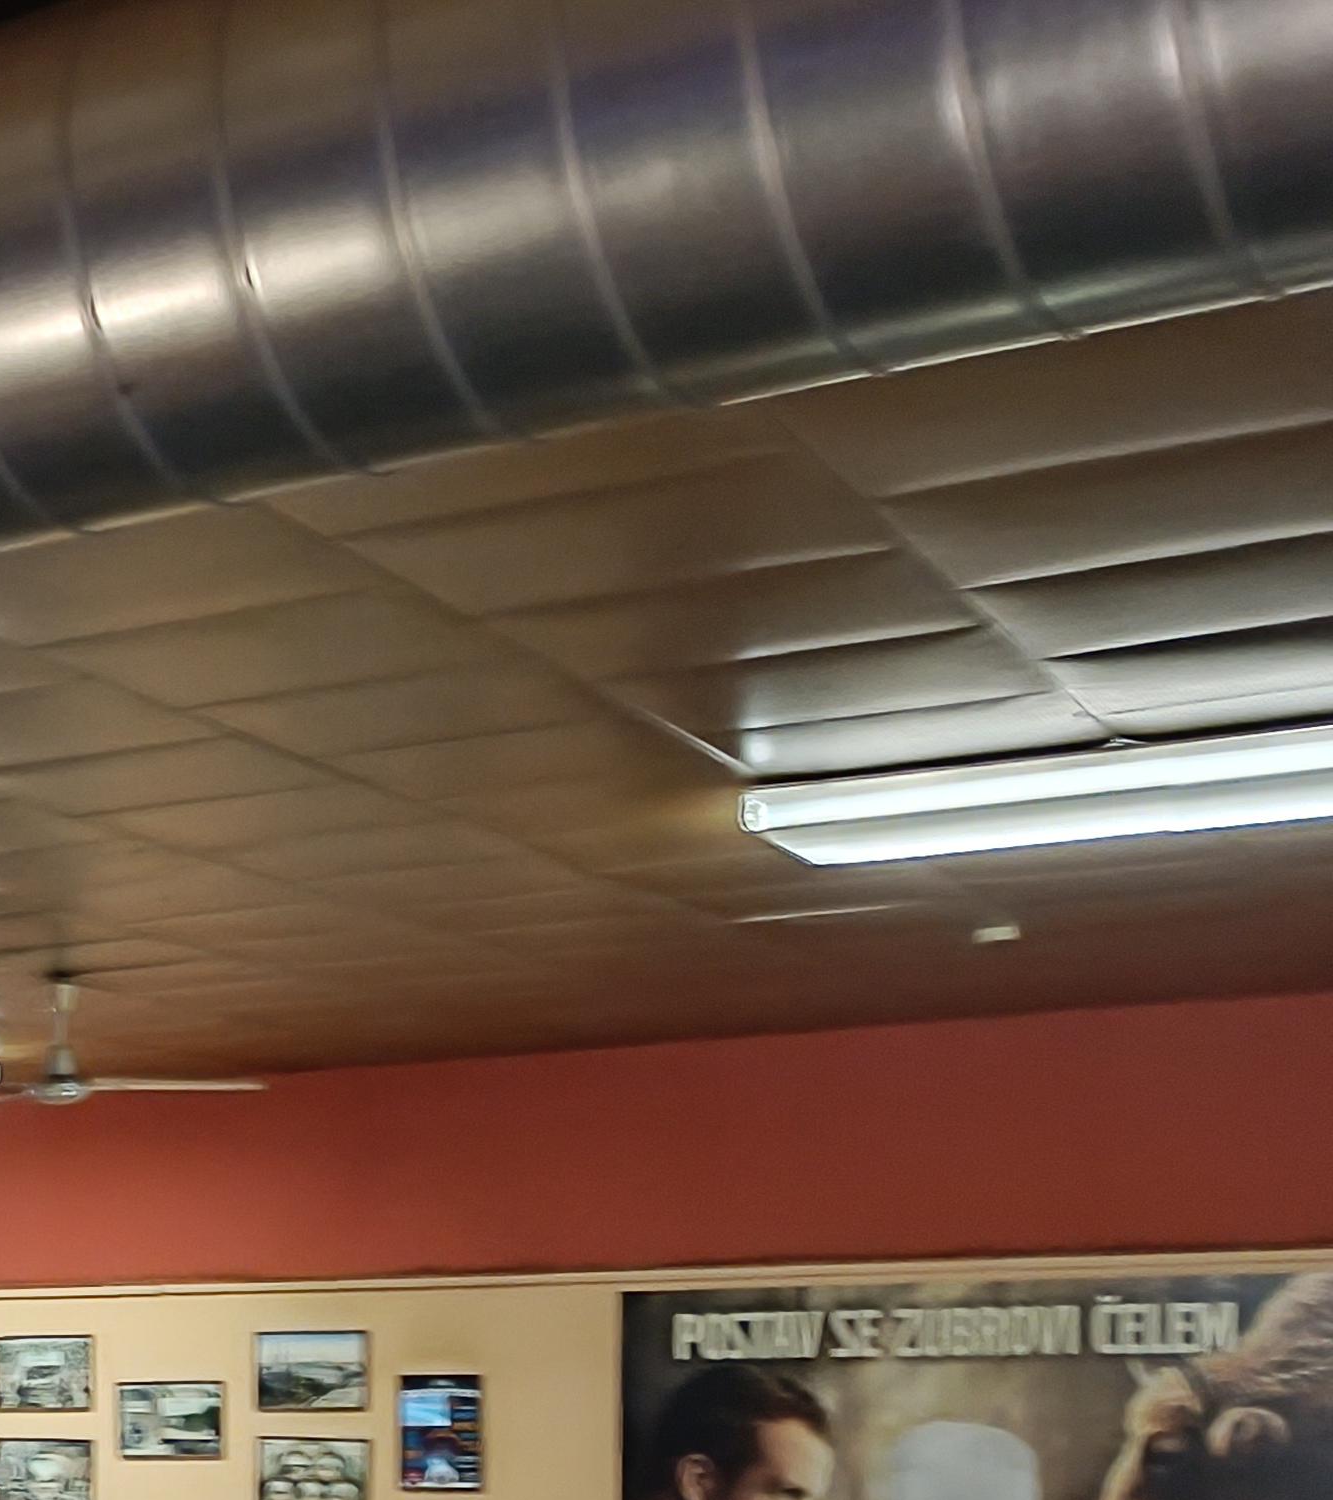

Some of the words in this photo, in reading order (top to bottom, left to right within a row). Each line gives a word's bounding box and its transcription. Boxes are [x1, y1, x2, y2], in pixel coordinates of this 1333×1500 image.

[672, 1312, 825, 1360] POSTAV
[828, 1309, 883, 1358] SE
[890, 1305, 1081, 1358] ZUBROVI
[1089, 1295, 1239, 1355] ČELEM
